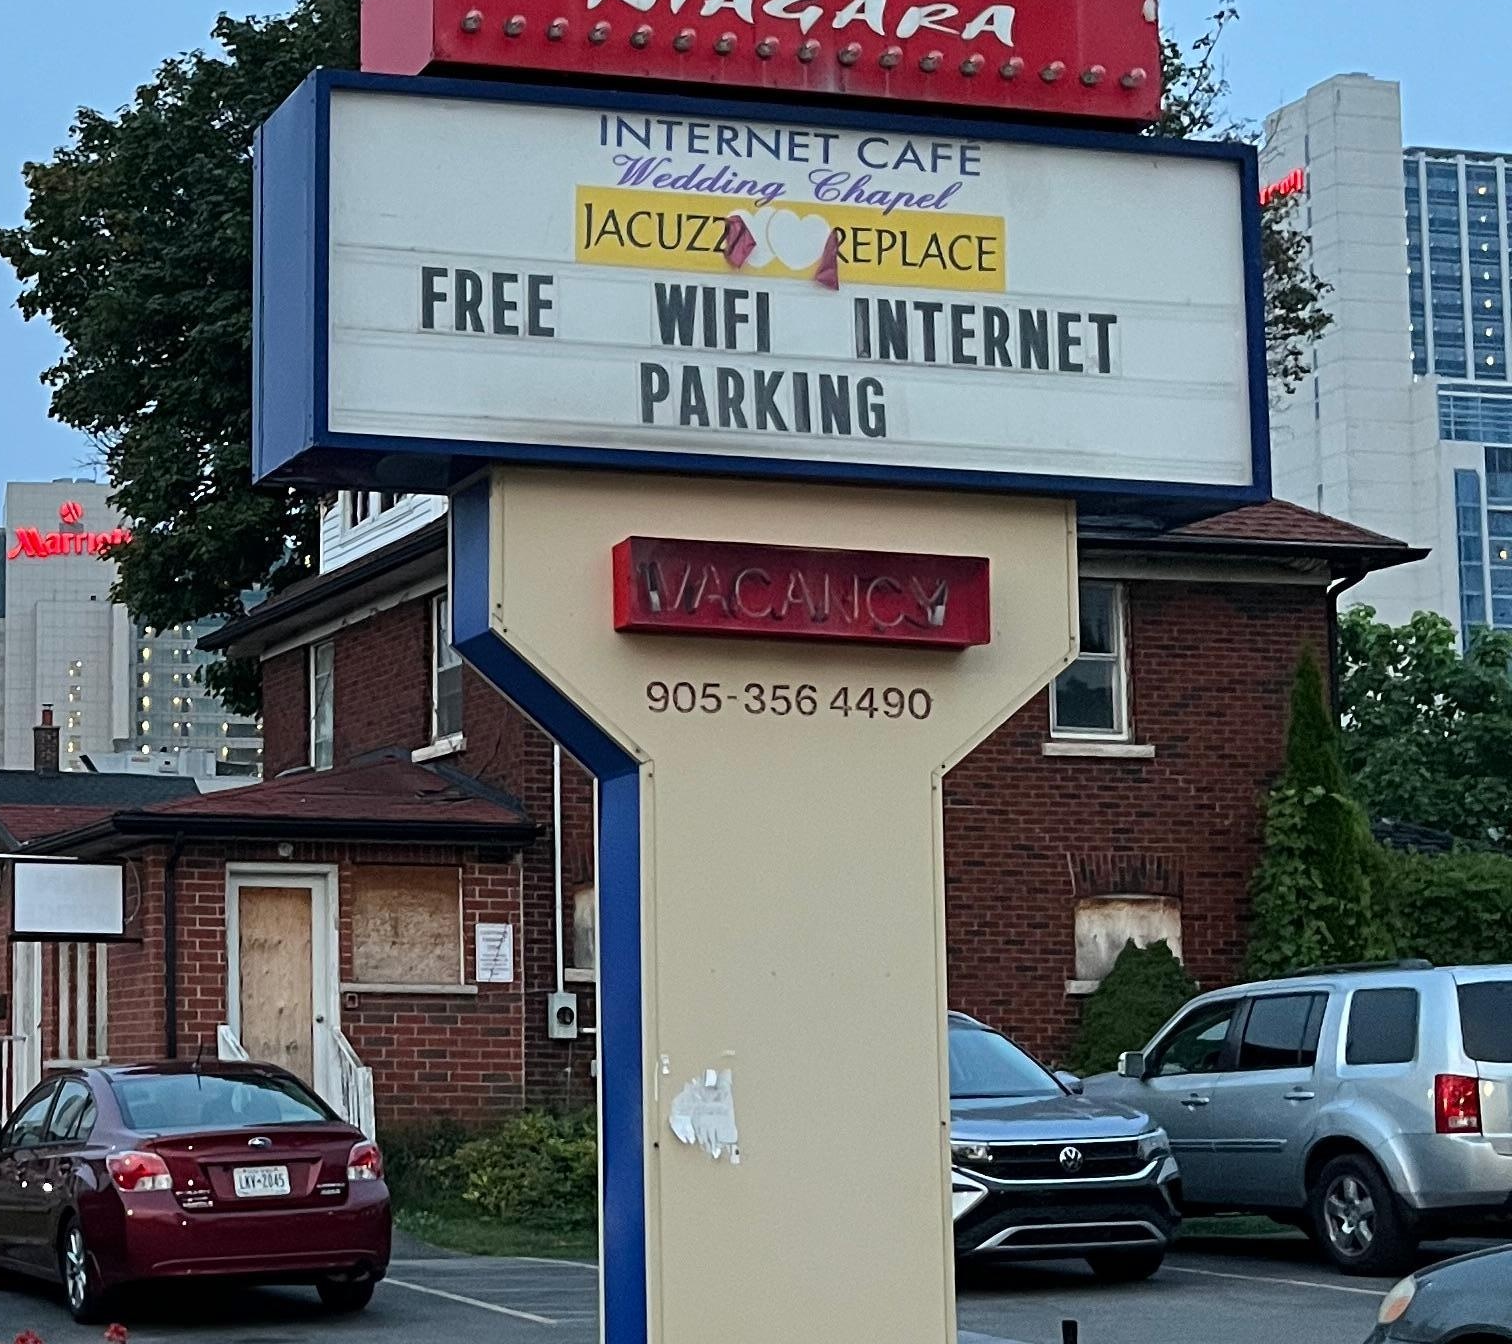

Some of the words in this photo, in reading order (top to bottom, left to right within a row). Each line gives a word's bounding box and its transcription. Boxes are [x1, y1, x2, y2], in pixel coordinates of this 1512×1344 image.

[599, 114, 840, 164] INTERNET
[613, 153, 787, 207] Wedding
[808, 168, 963, 216] Chapel
[584, 202, 731, 255] JACUZZ
[833, 226, 997, 272] REPLACE
[420, 266, 556, 338] FREE
[654, 282, 771, 354] WIFI
[854, 297, 1118, 375] INTERNET
[640, 361, 887, 438] PARKING
[636, 560, 950, 628] VACANCY
[645, 680, 818, 717] 905-356
[829, 685, 934, 720] 4490
